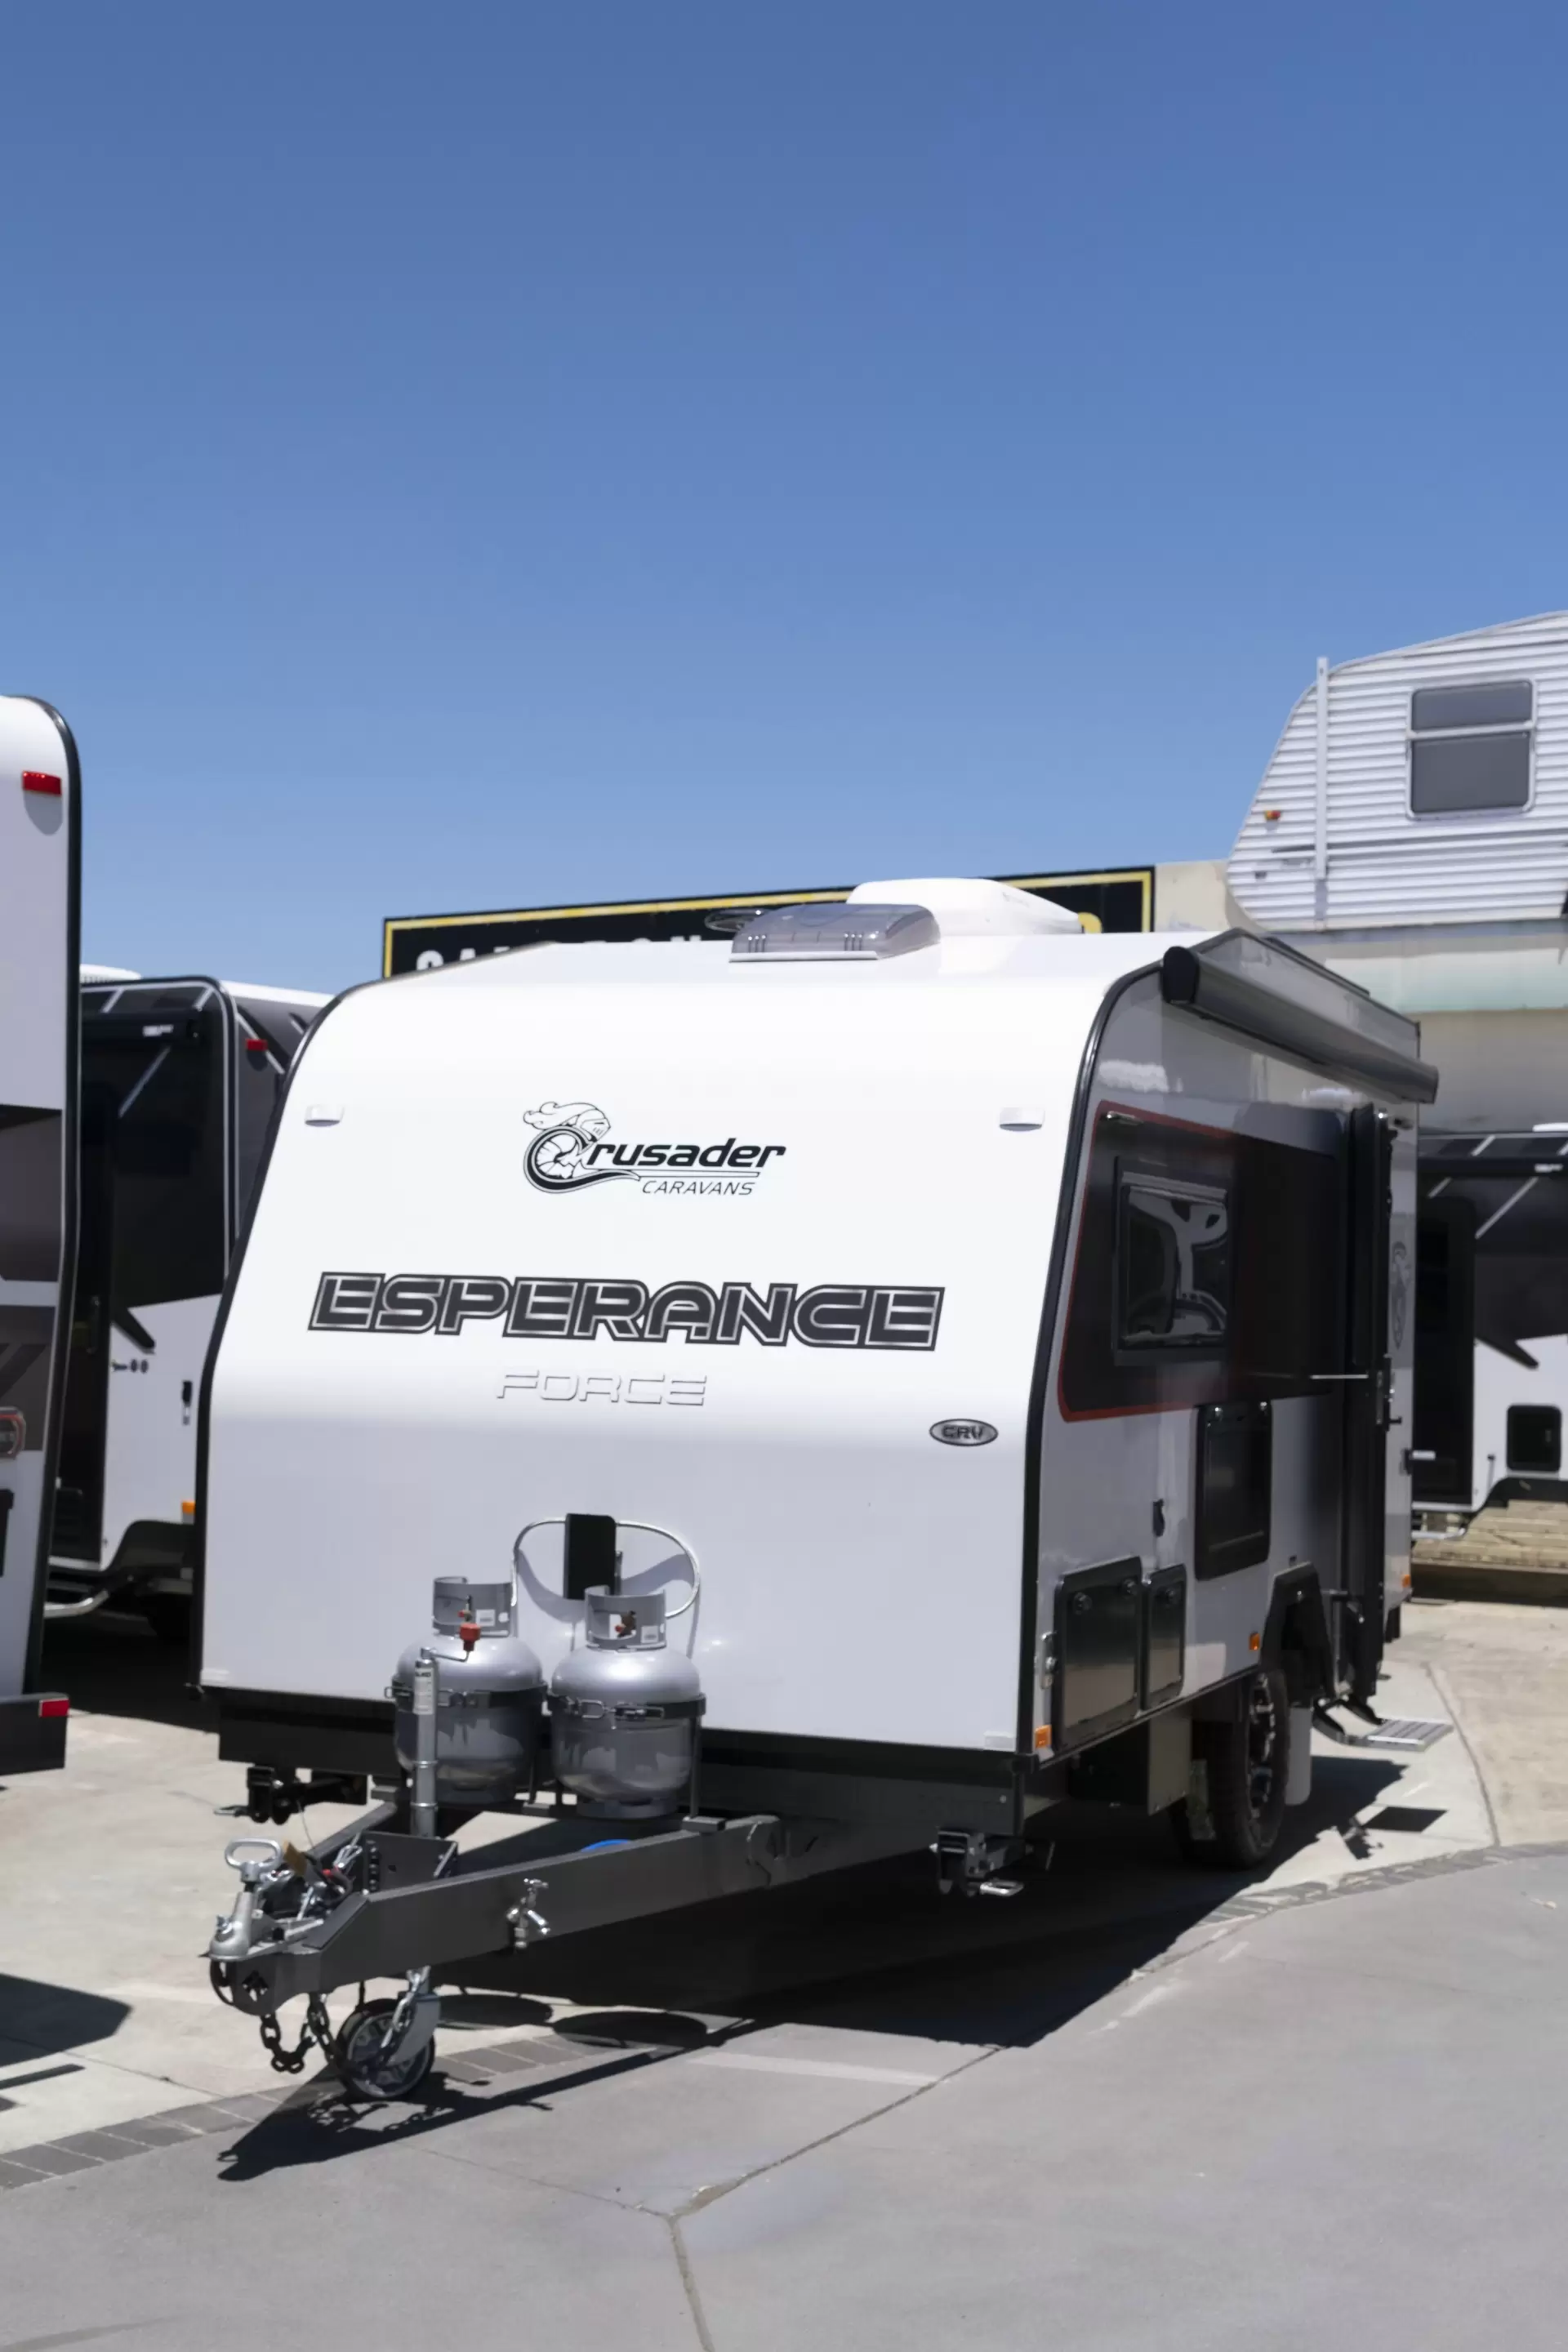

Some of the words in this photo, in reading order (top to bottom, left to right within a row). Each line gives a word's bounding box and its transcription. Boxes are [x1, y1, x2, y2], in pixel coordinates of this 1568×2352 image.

[642, 1180, 758, 1196] CARAVANS
[307, 1272, 946, 1352] ESPERANCE
[496, 1369, 707, 1406] FORCE
